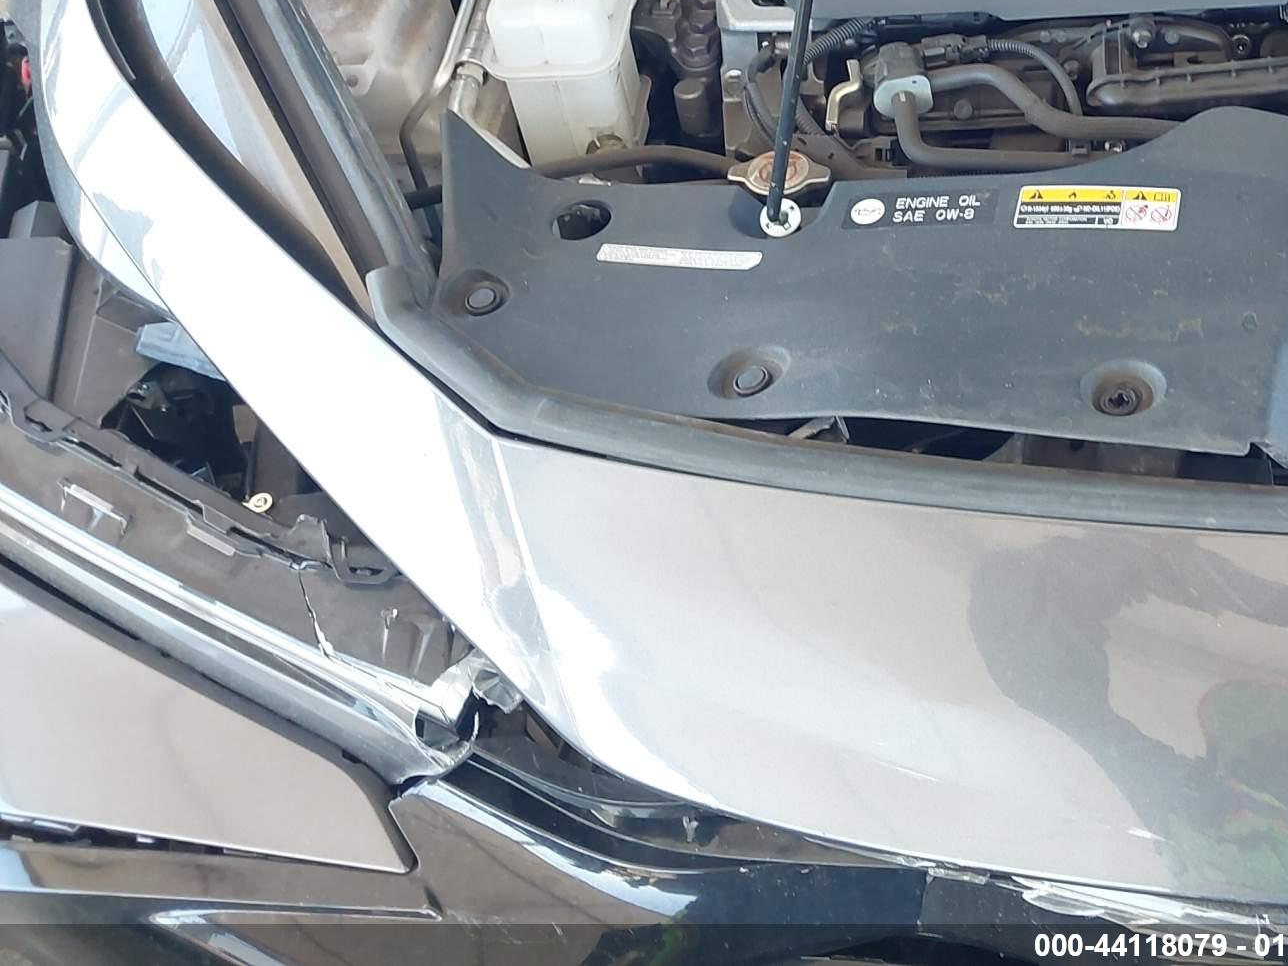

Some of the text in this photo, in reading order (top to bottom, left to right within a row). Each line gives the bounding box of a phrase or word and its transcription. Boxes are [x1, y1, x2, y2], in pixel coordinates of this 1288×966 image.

[895, 194, 981, 210] ENGINE OIL
[892, 210, 926, 223] SAE
